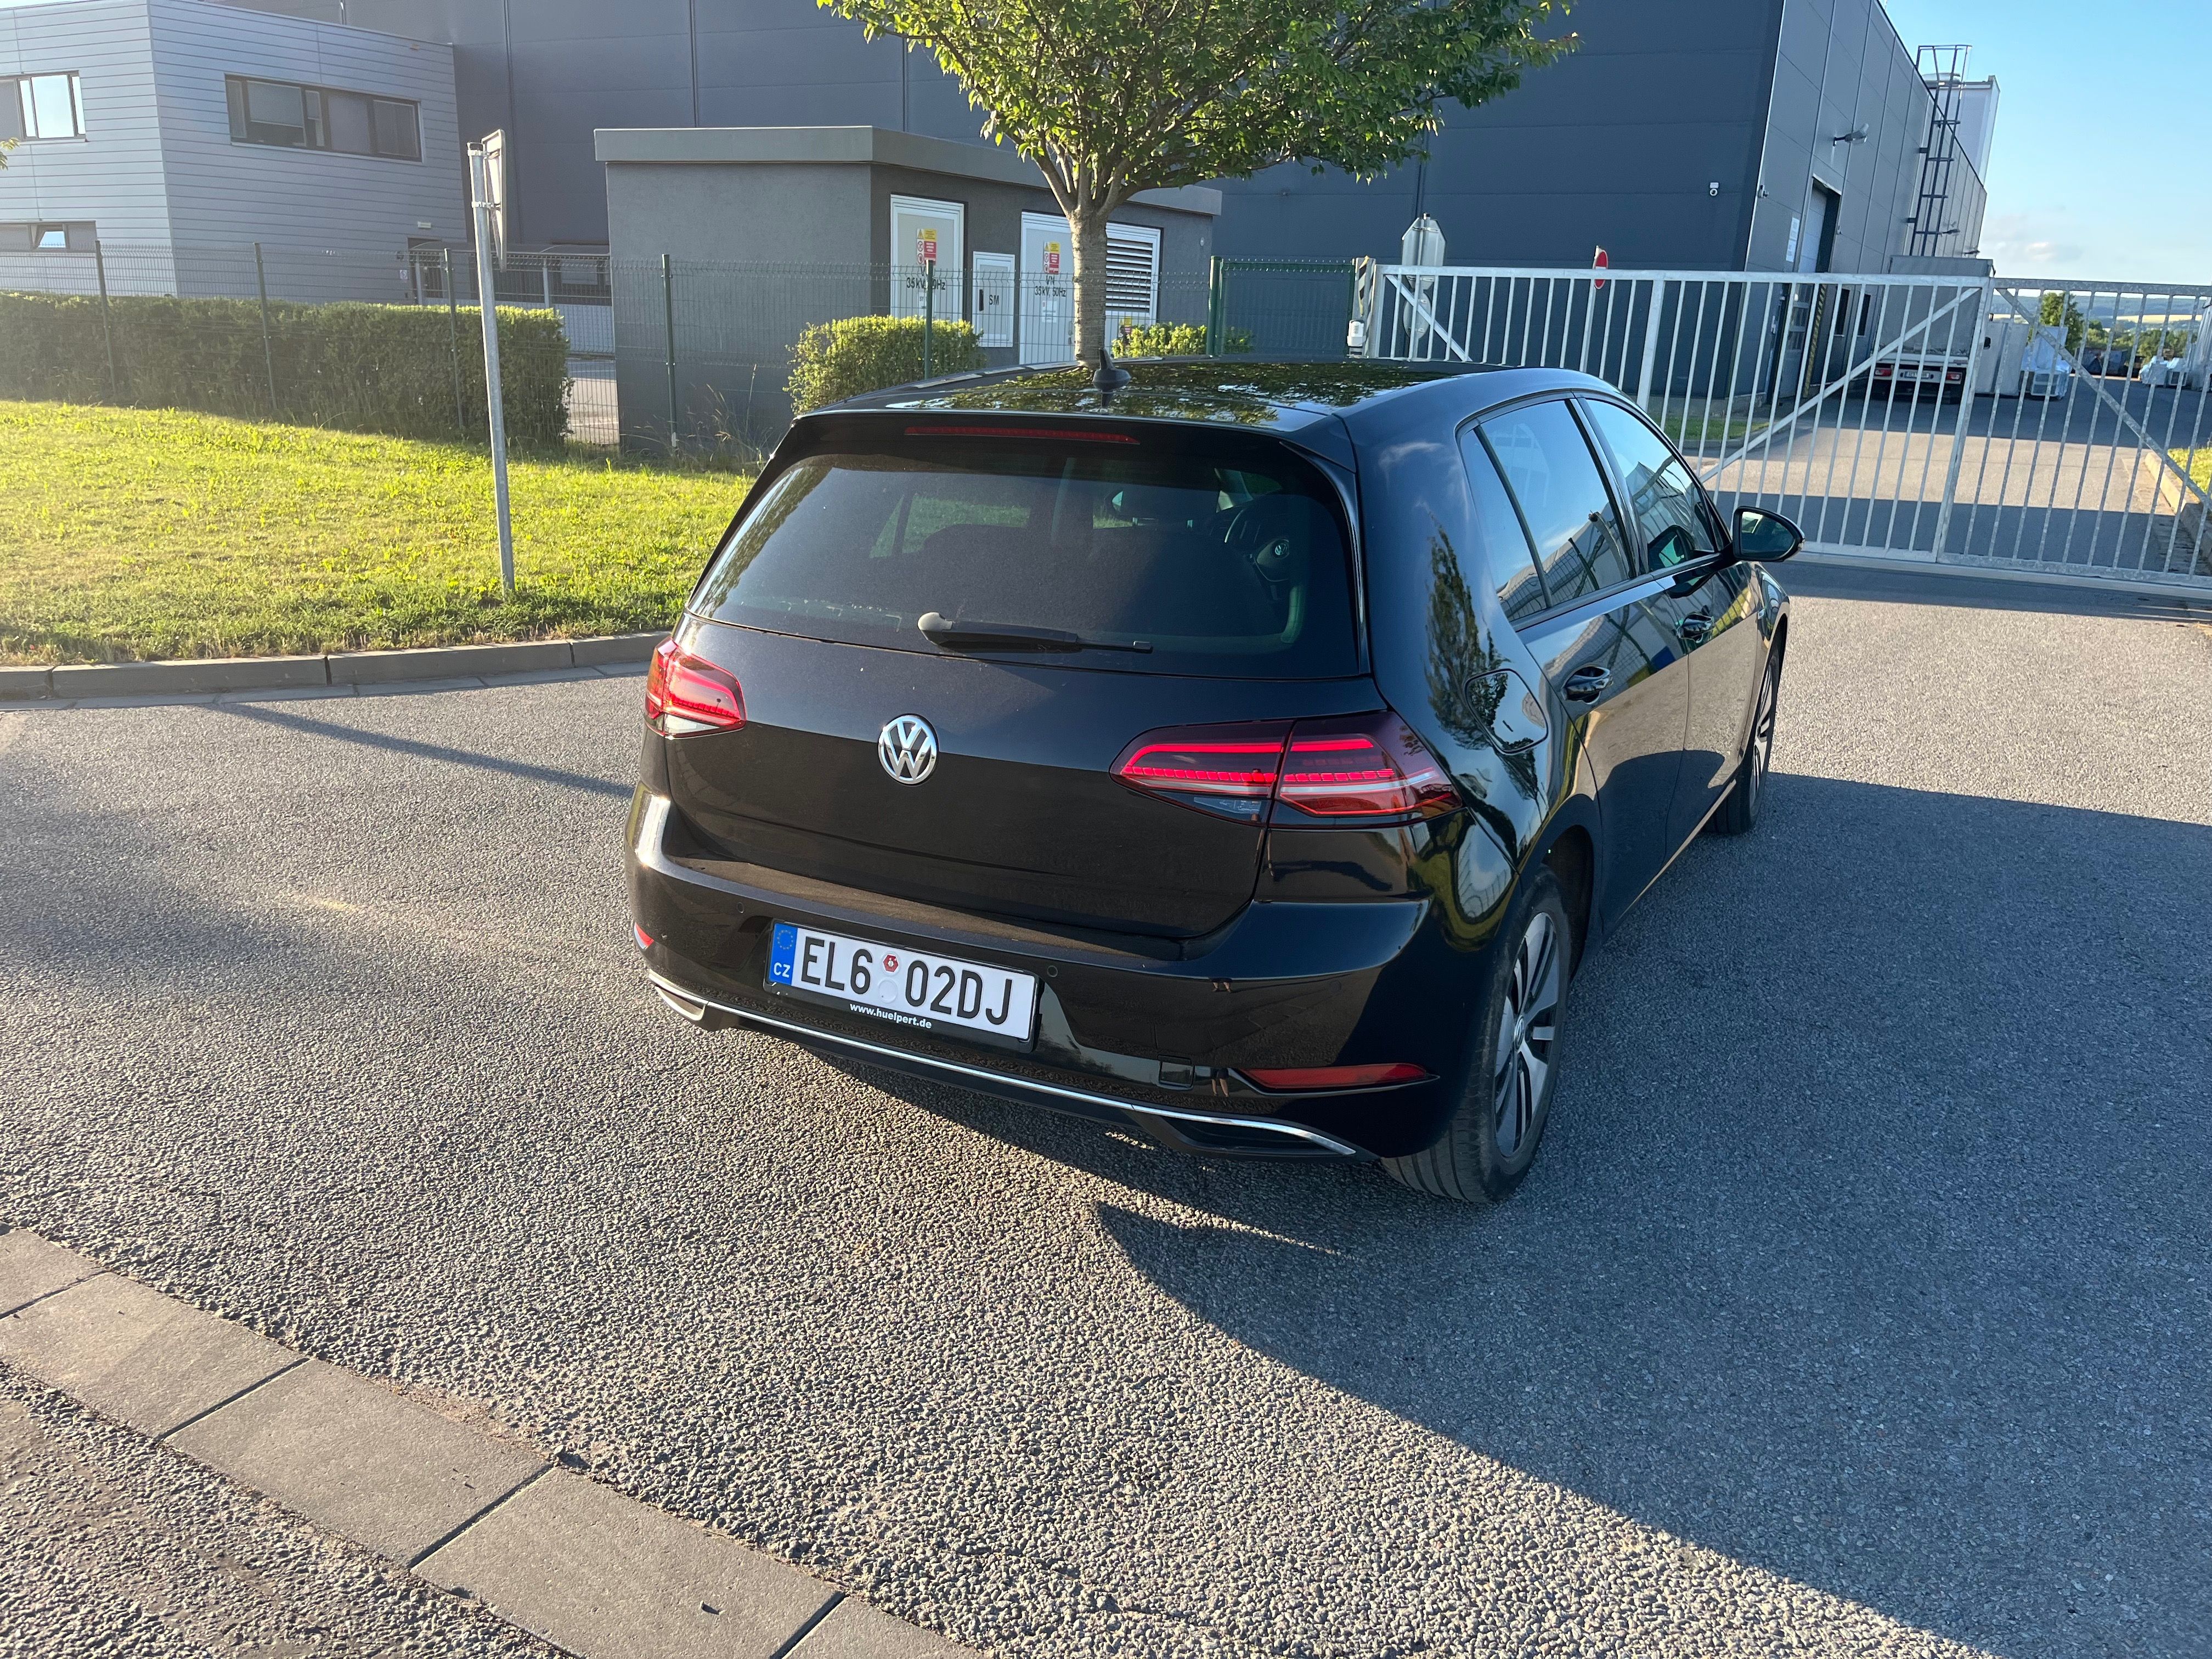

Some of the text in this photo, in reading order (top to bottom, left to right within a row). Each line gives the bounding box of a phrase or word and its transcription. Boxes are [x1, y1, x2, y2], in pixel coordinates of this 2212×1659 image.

[932, 279, 945, 290] 0Hz
[989, 294, 999, 306] SM
[878, 715, 936, 785] VW
[773, 962, 791, 978] CZ
[801, 936, 1012, 1025] EL6 02DJ
[850, 1003, 932, 1029] www.huelpert.de
